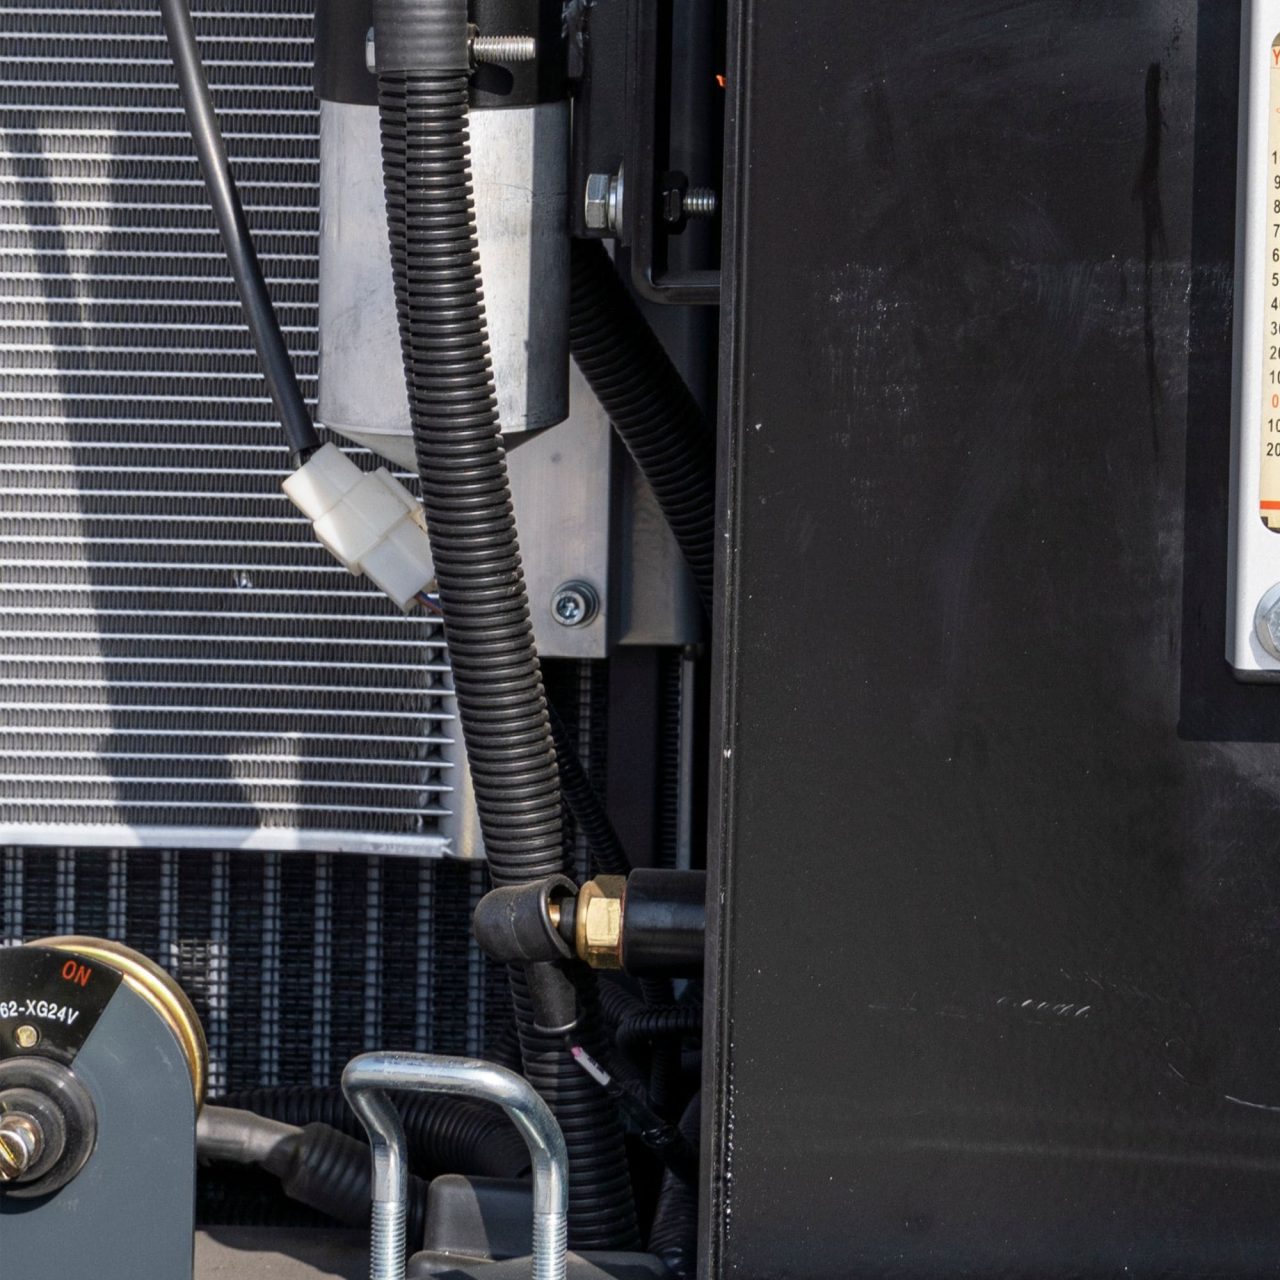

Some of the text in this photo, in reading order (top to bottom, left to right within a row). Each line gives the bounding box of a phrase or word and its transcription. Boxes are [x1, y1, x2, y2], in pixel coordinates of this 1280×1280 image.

[1272, 394, 1279, 408] 0
[62, 960, 91, 987] ON
[0, 999, 80, 1025] 62-XG24V
